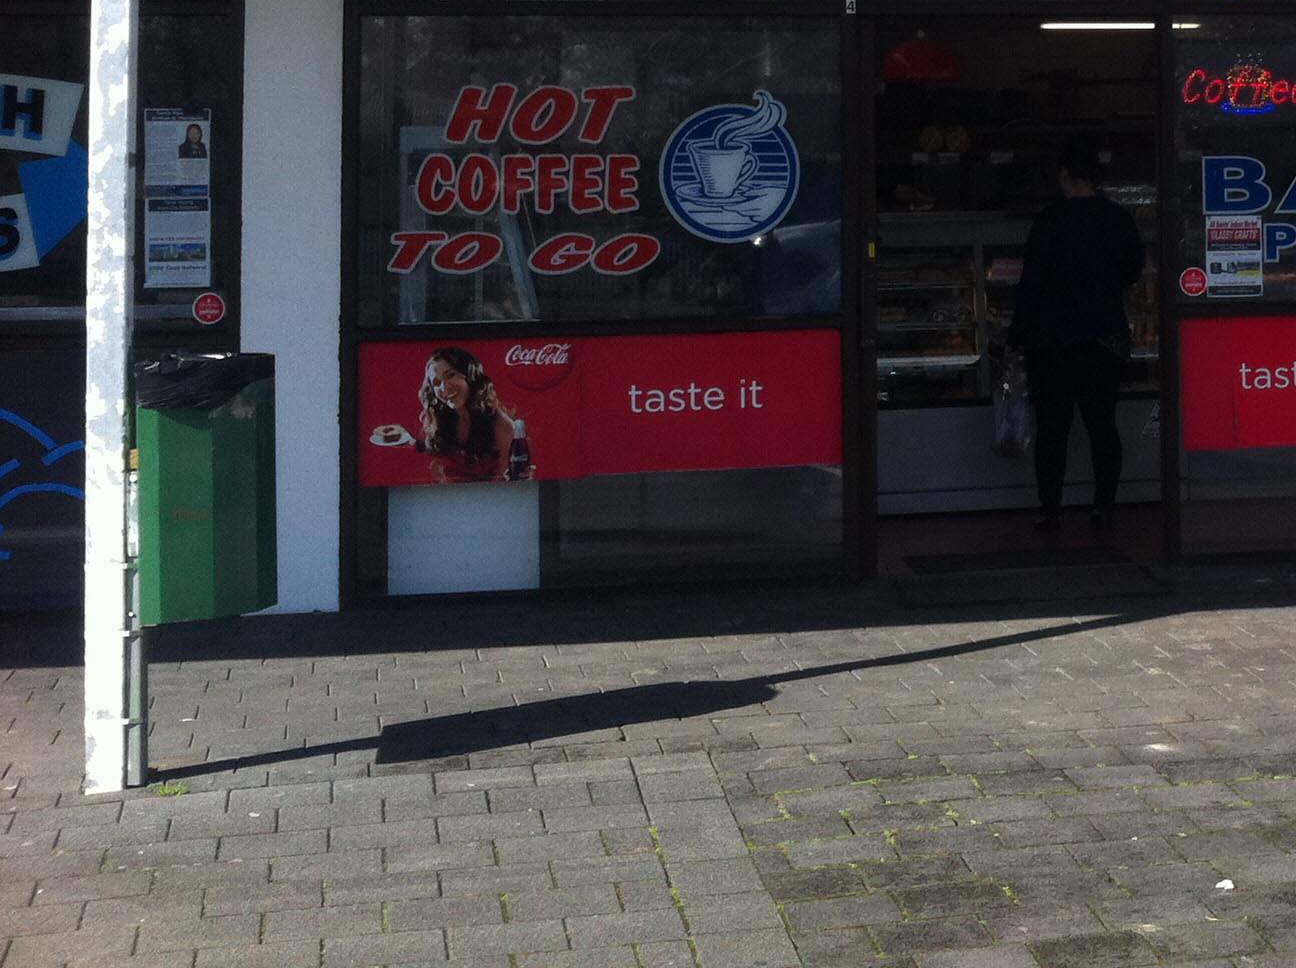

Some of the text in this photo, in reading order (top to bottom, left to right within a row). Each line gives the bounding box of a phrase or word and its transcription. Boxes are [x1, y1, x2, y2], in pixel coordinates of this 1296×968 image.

[444, 82, 636, 145] HOT
[415, 152, 641, 216] COFFEE
[387, 231, 662, 276] TO GO
[504, 342, 574, 367] Coca-Cola
[628, 378, 764, 414] taste it
